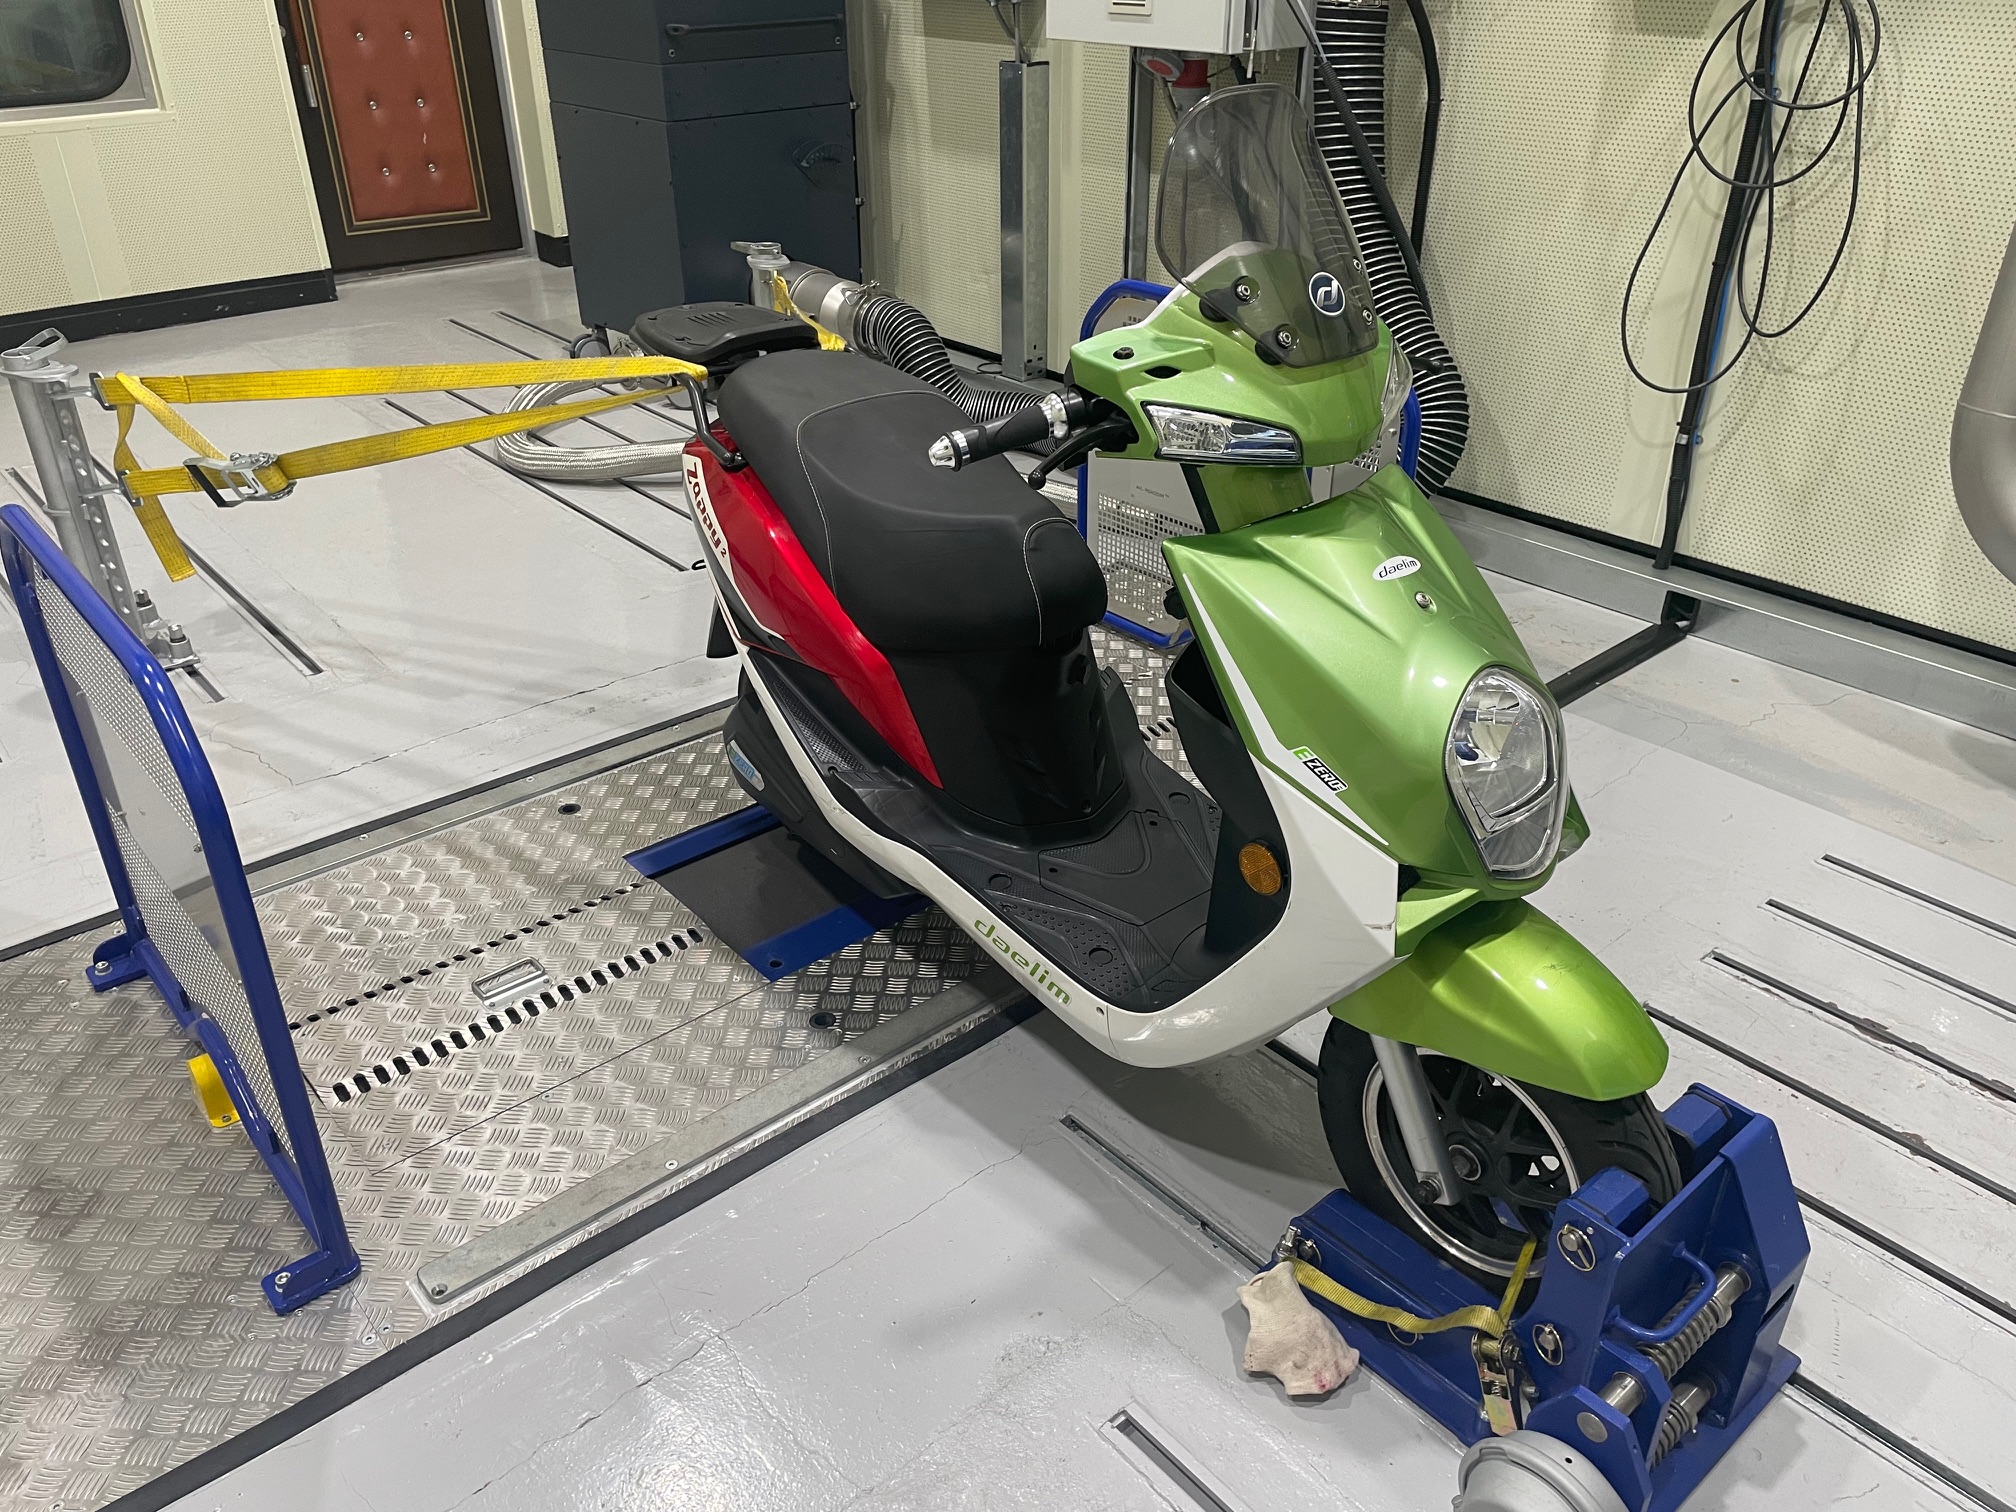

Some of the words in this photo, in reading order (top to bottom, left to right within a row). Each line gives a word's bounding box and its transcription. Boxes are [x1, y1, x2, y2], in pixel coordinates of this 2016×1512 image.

[686, 461, 722, 550] Zappy
[1378, 558, 1418, 579] daelim
[974, 919, 1071, 1005] daelim
